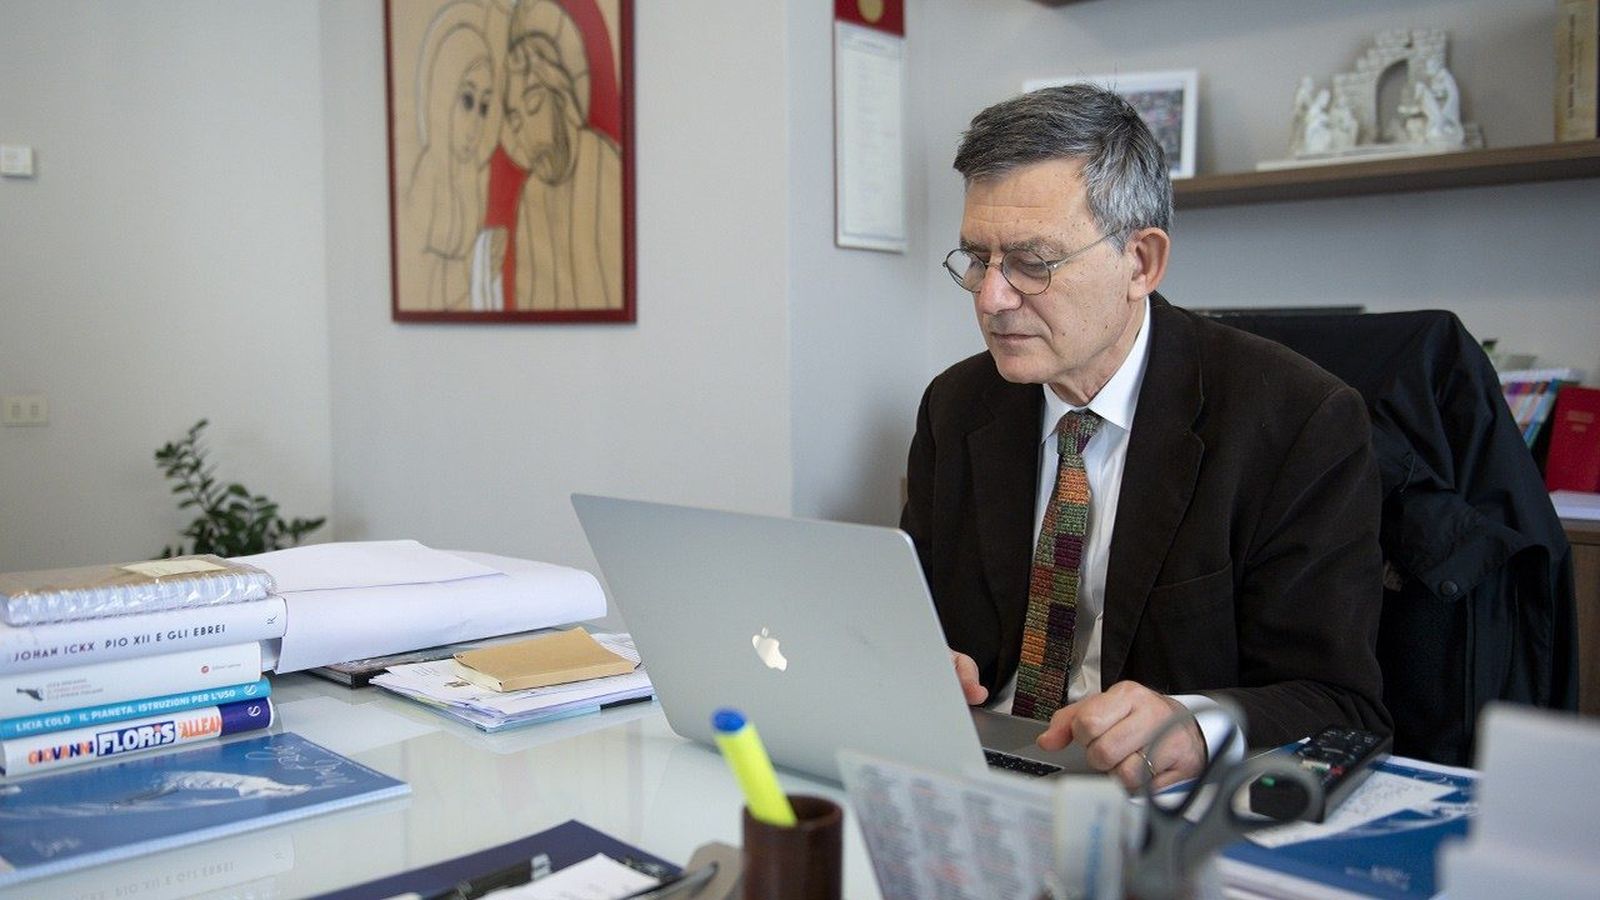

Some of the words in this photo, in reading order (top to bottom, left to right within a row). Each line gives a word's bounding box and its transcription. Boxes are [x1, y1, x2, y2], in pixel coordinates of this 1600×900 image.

[105, 637, 128, 649] PIO
[133, 634, 150, 646] XII
[156, 632, 163, 642] E
[167, 629, 188, 640] GLI
[193, 624, 225, 637] EBREI
[14, 647, 58, 661] JOHAN
[64, 642, 95, 655] ICKX
[79, 713, 89, 722] IL
[138, 698, 189, 712] ISTRUZIONI
[192, 694, 209, 704] PER
[211, 689, 236, 700] L'USO
[16, 719, 43, 732] LICIA
[28, 741, 95, 765] GIOVANNI
